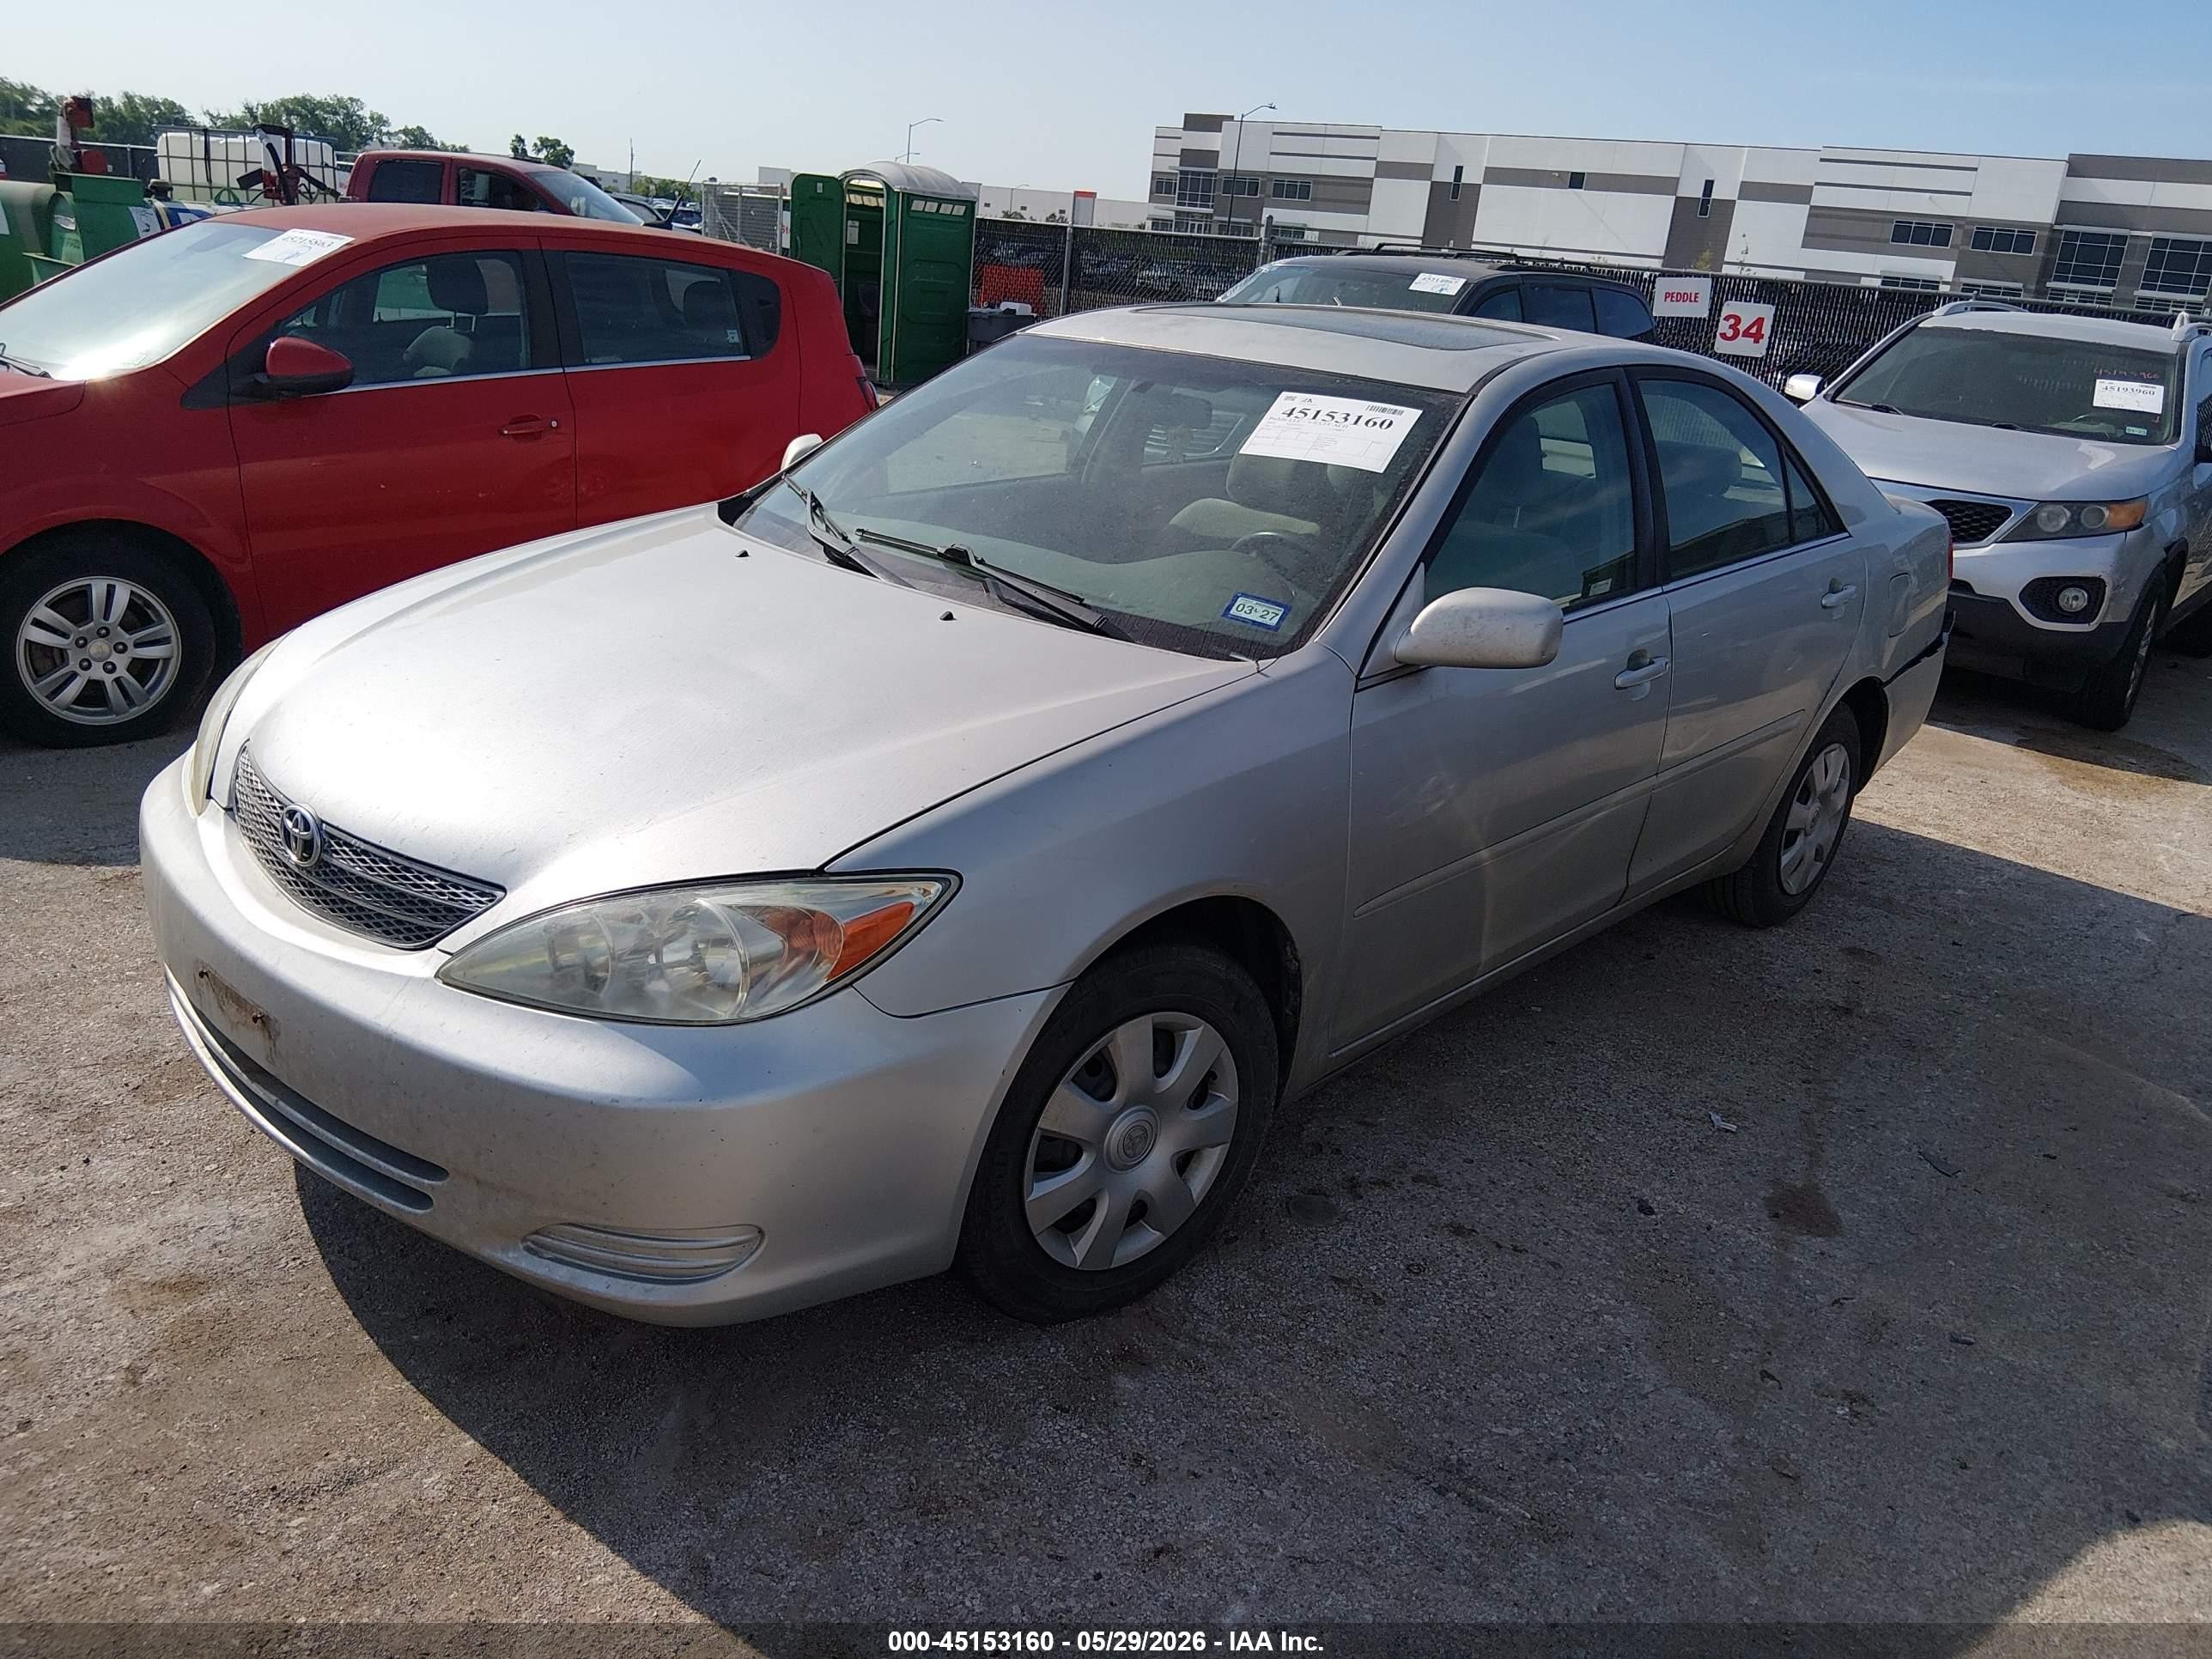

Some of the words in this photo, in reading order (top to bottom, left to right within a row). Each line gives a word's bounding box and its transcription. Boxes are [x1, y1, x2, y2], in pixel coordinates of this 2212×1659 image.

[1664, 291, 1700, 303] PEDDLE
[1719, 313, 1765, 344] 34
[1281, 406, 1395, 431] 45153160
